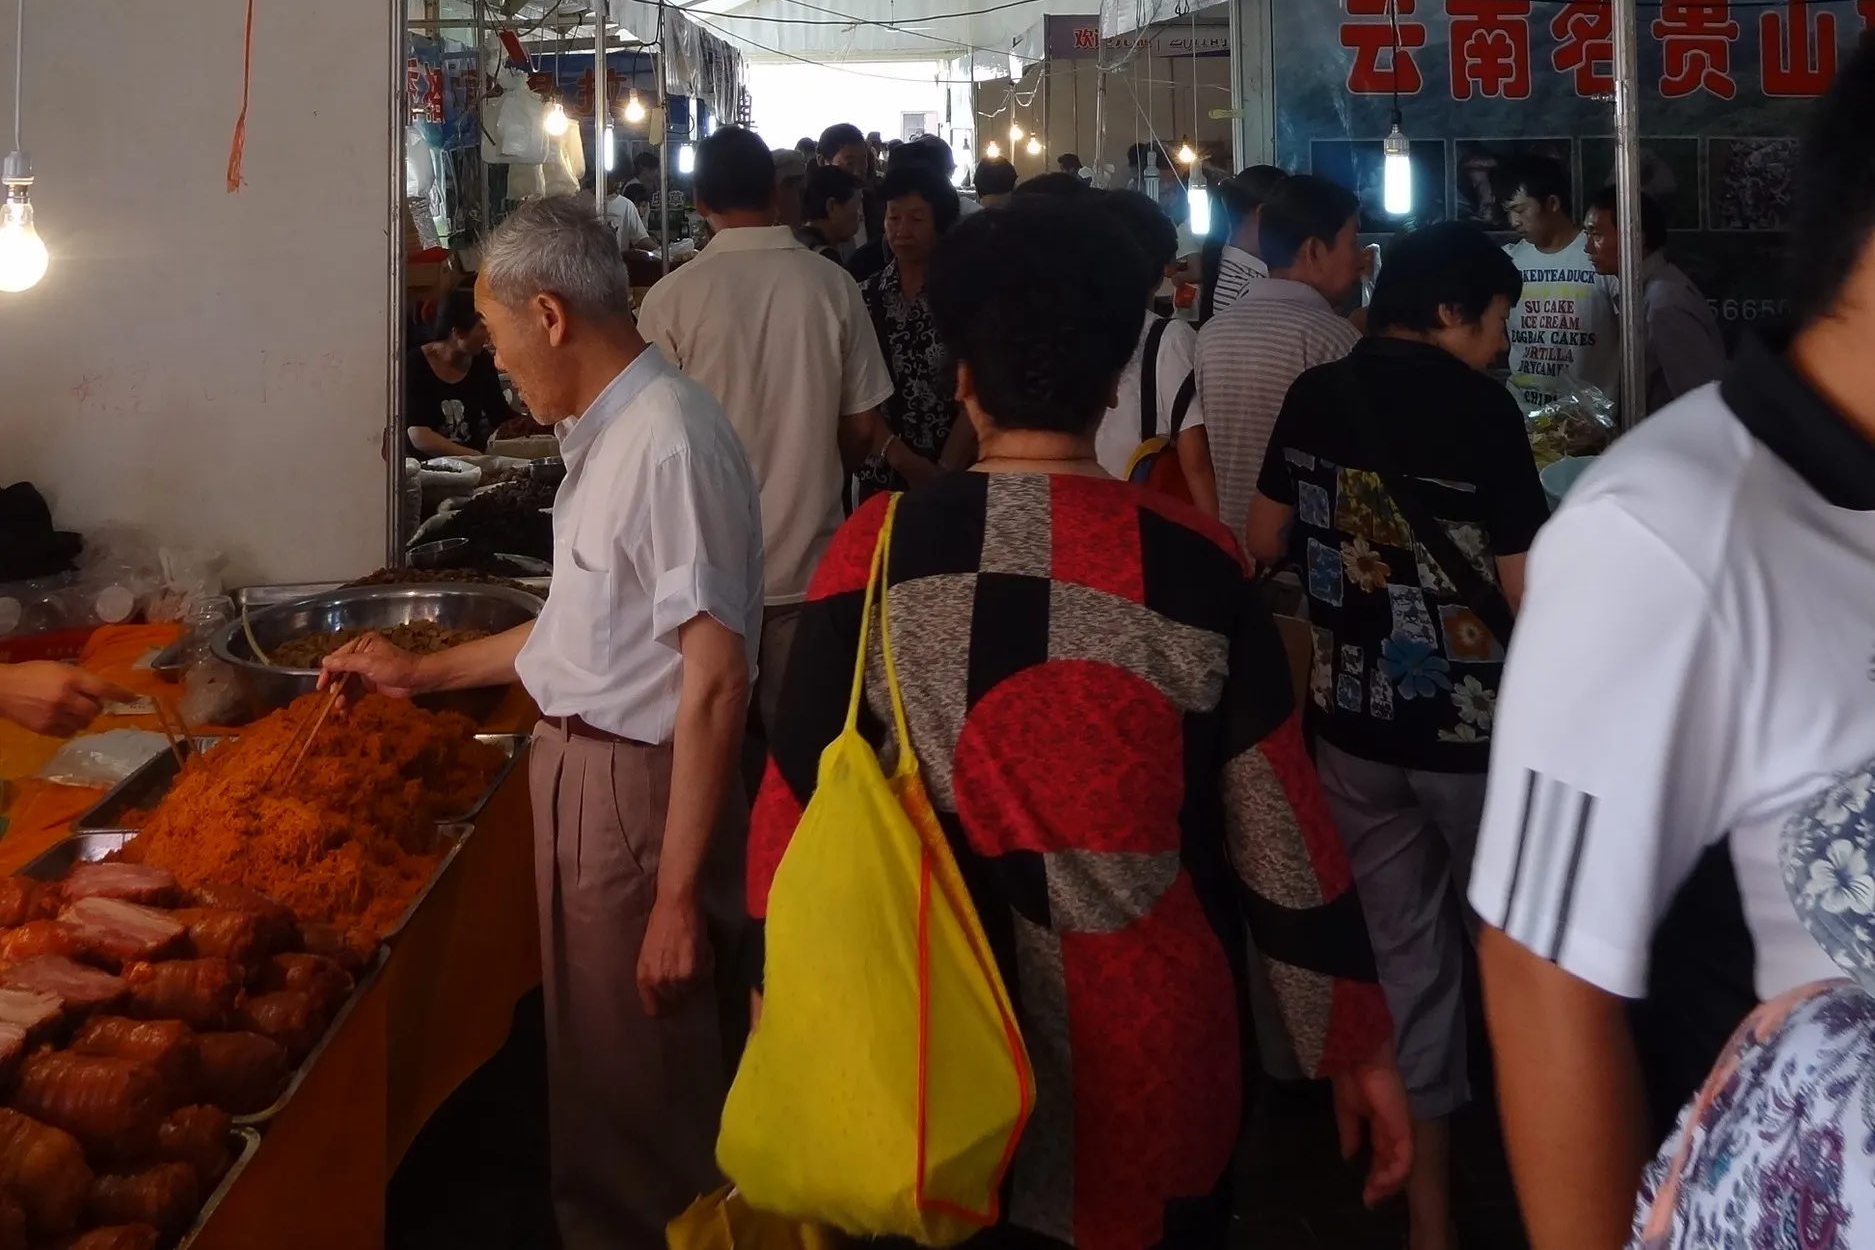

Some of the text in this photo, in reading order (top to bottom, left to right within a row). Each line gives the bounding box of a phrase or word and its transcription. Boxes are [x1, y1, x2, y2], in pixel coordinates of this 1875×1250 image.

[1525, 300, 1574, 314] SU CAKE
[1521, 316, 1580, 330] ICE CREAM
[1550, 331, 1596, 346] CAKES
